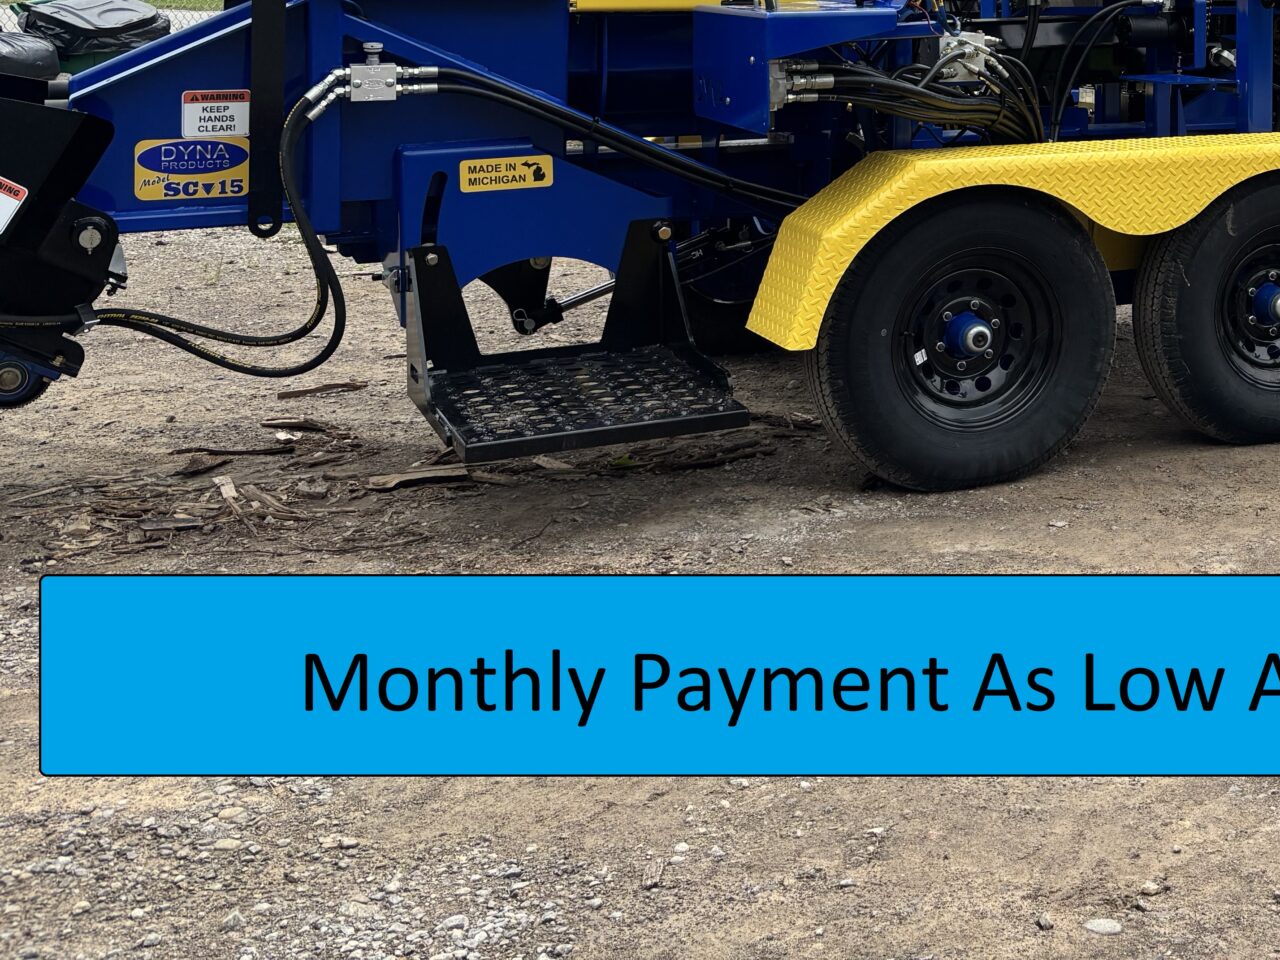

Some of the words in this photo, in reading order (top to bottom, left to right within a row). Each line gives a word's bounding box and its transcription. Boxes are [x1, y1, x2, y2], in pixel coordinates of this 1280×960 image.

[200, 93, 246, 101] WARNING
[202, 105, 230, 113] KEEP
[198, 114, 236, 123] HANDS
[197, 124, 236, 133] CLEAR!
[161, 144, 230, 161] DYNA
[161, 159, 230, 170] PRODUCTS
[467, 163, 502, 175] MADE
[505, 162, 517, 171] IN
[139, 174, 171, 192] Model
[467, 174, 527, 187] MICHIGAN
